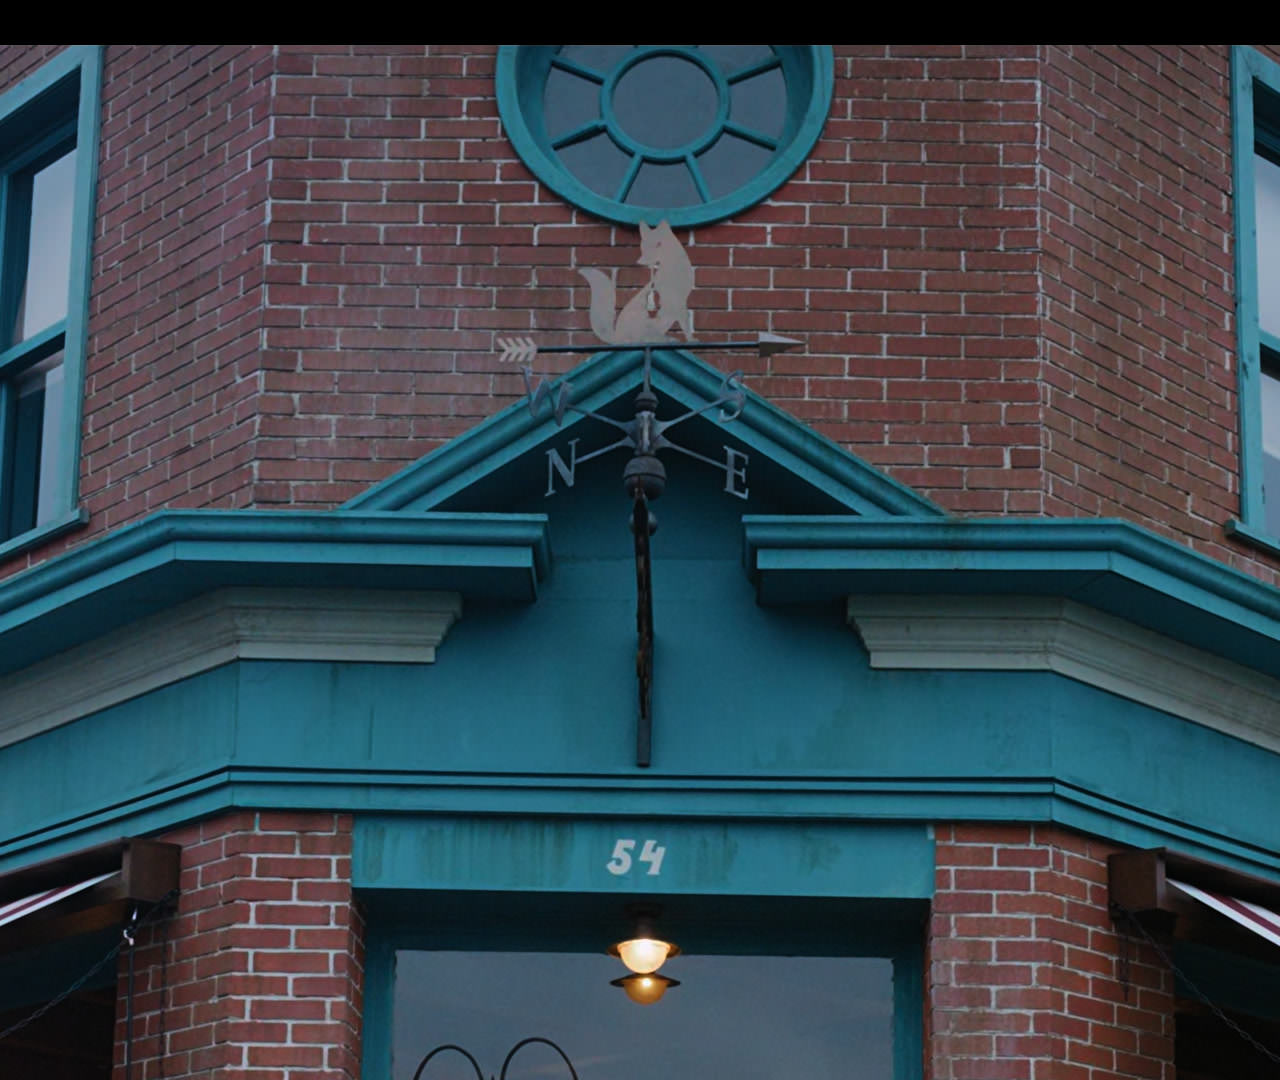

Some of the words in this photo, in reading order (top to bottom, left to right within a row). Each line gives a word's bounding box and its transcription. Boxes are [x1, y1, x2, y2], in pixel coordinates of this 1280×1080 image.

[544, 437, 581, 498] N
[722, 444, 750, 500] E
[606, 838, 667, 876] 54
